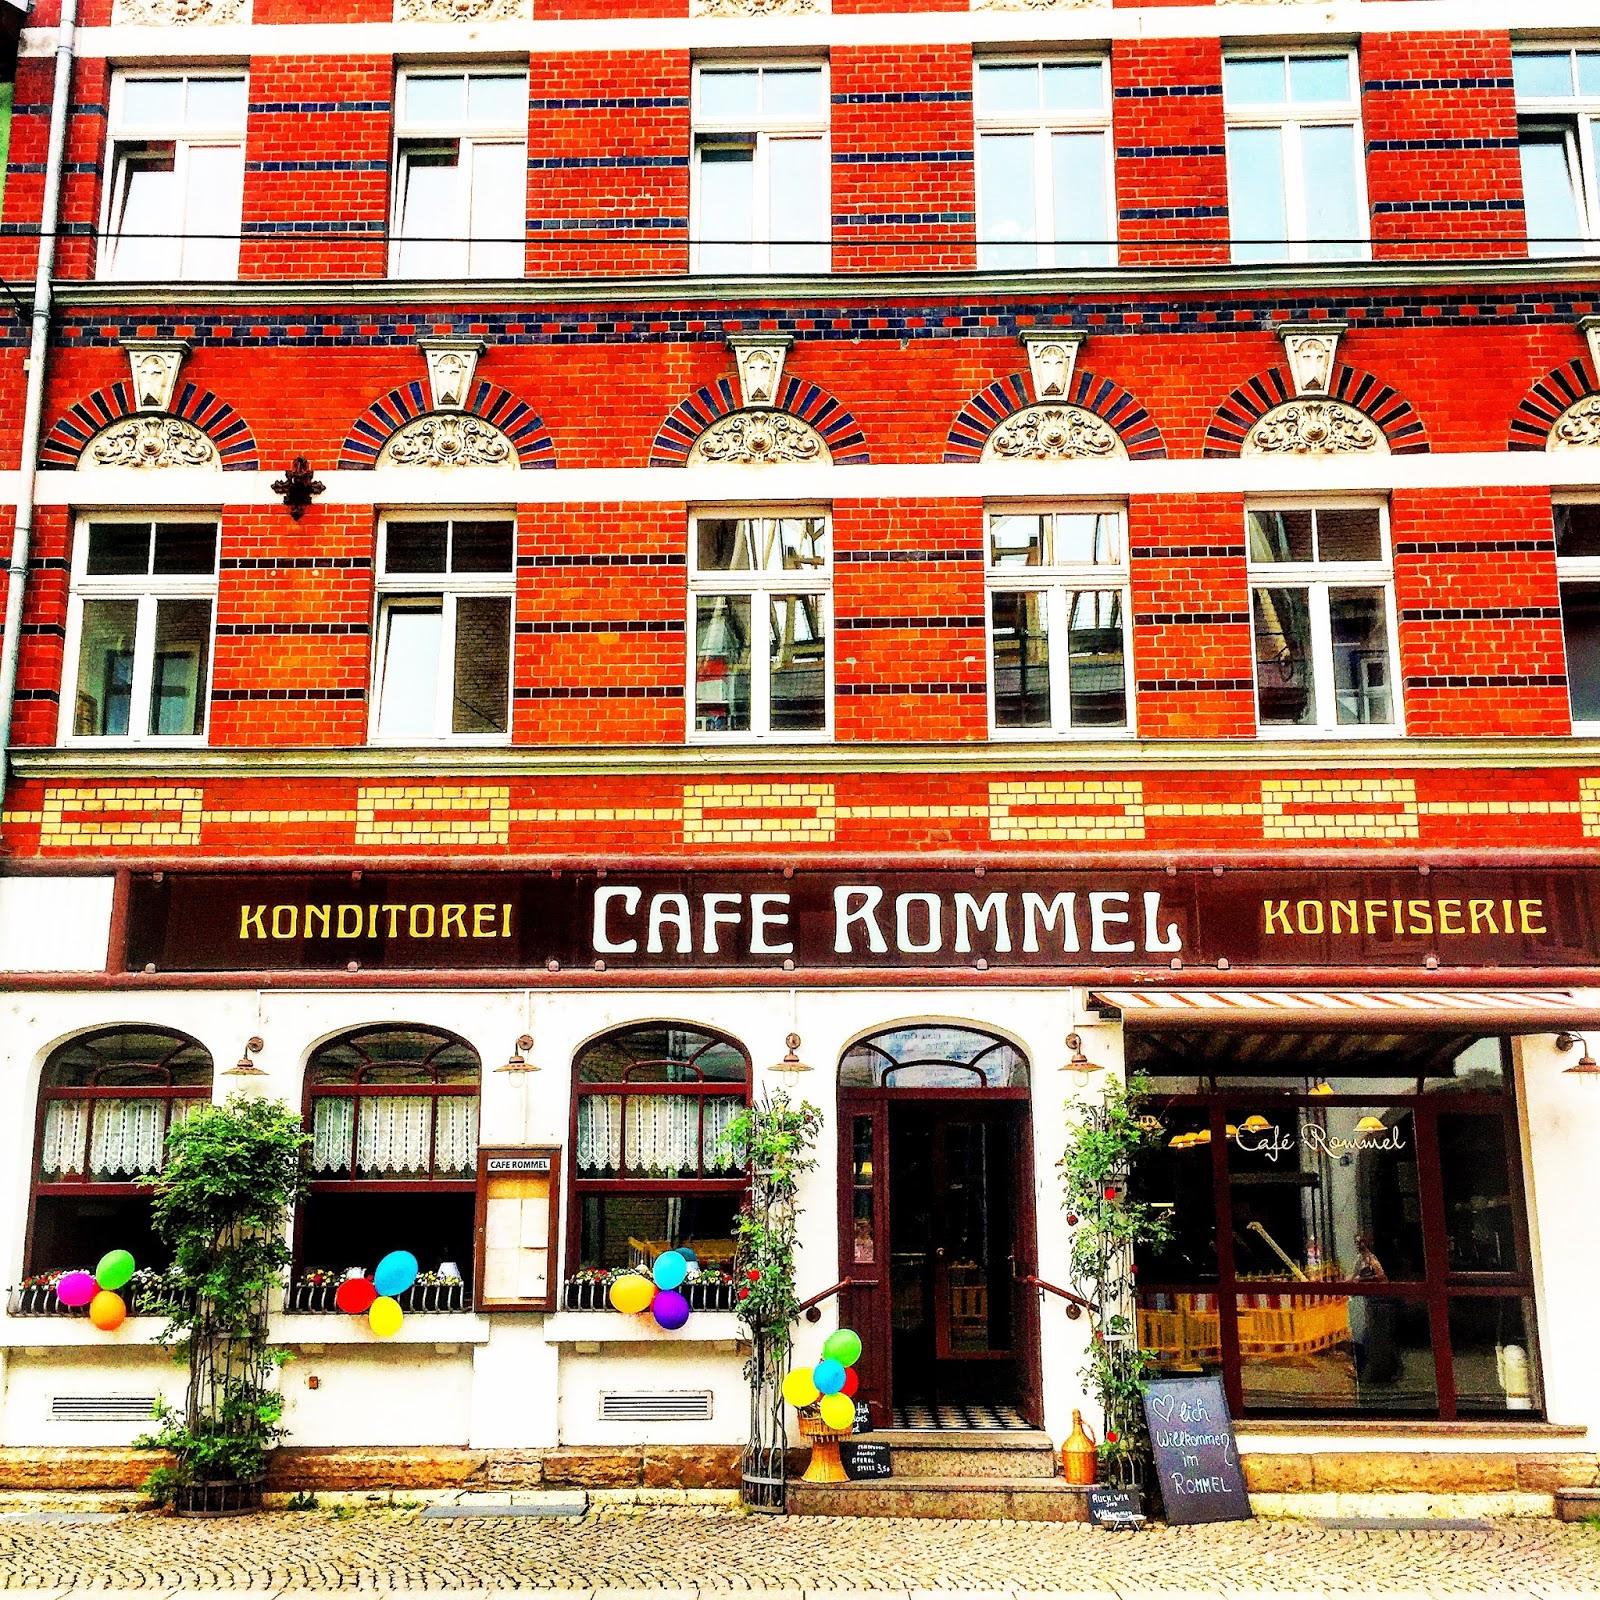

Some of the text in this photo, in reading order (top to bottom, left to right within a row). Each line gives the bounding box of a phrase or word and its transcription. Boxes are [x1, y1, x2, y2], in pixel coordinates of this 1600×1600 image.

[240, 903, 512, 939] KONDITOREI
[592, 885, 1183, 954] CAFE ROMMEL
[1263, 899, 1547, 935] KONFISERIE
[1235, 1122, 1406, 1162] Café Rommel
[1179, 1399, 1211, 1423] lich
[1156, 1430, 1233, 1466] Willkommen
[1182, 1452, 1199, 1468] im
[1171, 1472, 1233, 1495] ROMMEL
